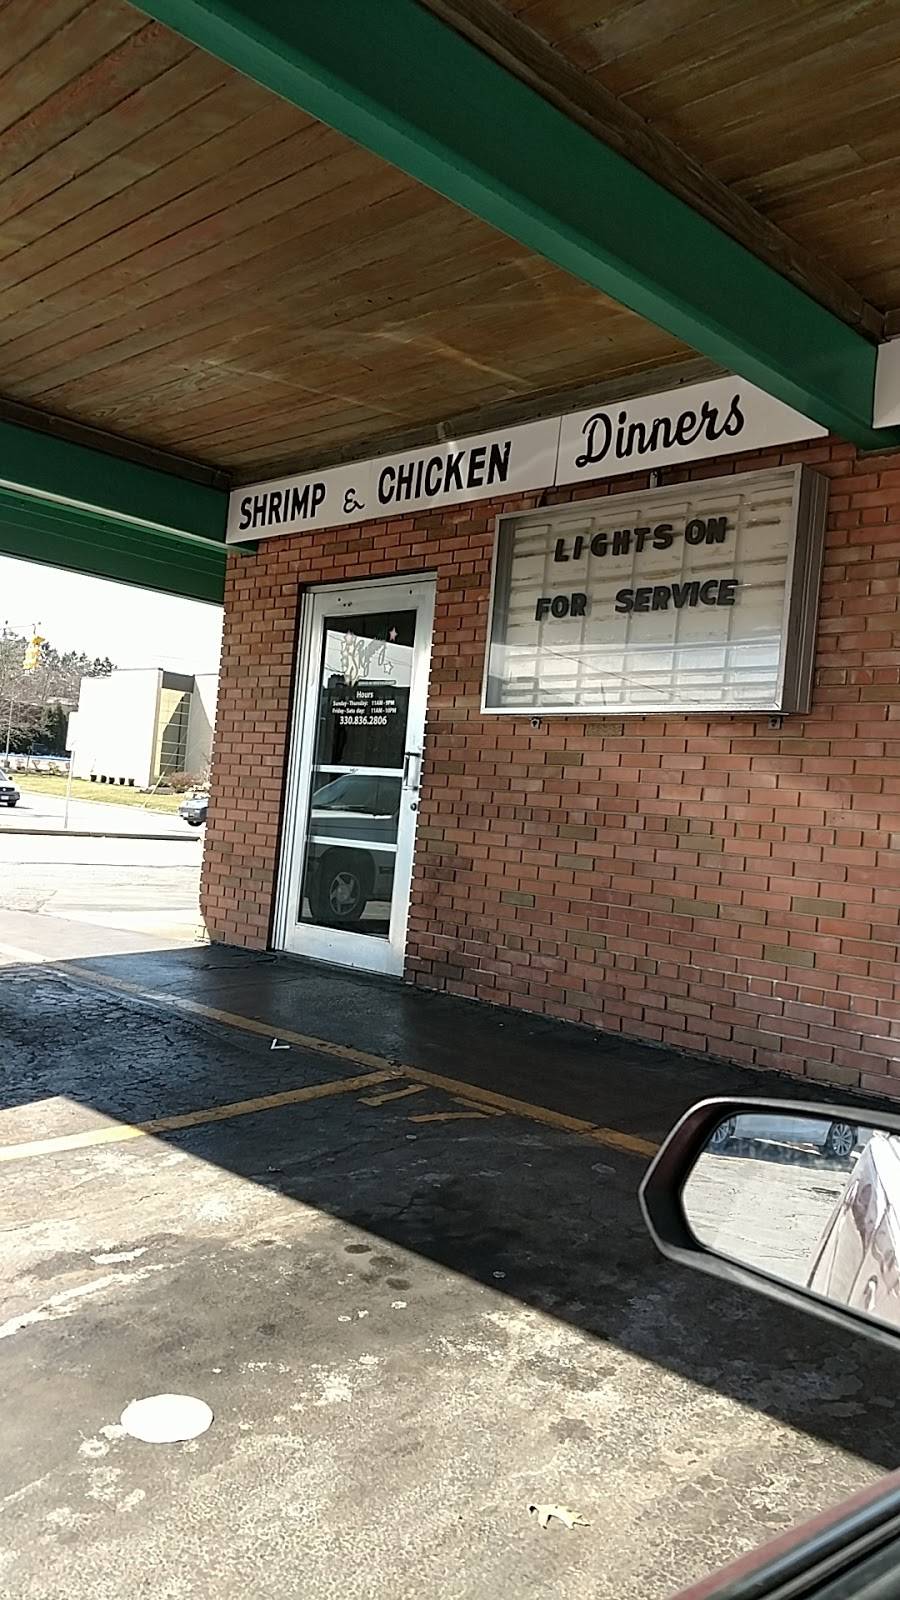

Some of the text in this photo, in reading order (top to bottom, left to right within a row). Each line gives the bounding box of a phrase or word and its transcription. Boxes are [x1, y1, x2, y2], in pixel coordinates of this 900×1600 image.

[238, 394, 745, 530] SHRIMP & CHICKEN Dinners
[554, 516, 728, 562] LIGHTS ON
[535, 579, 739, 621] FOR SERVICE
[356, 690, 374, 699] Hours
[339, 715, 388, 725] 330.836.2806
